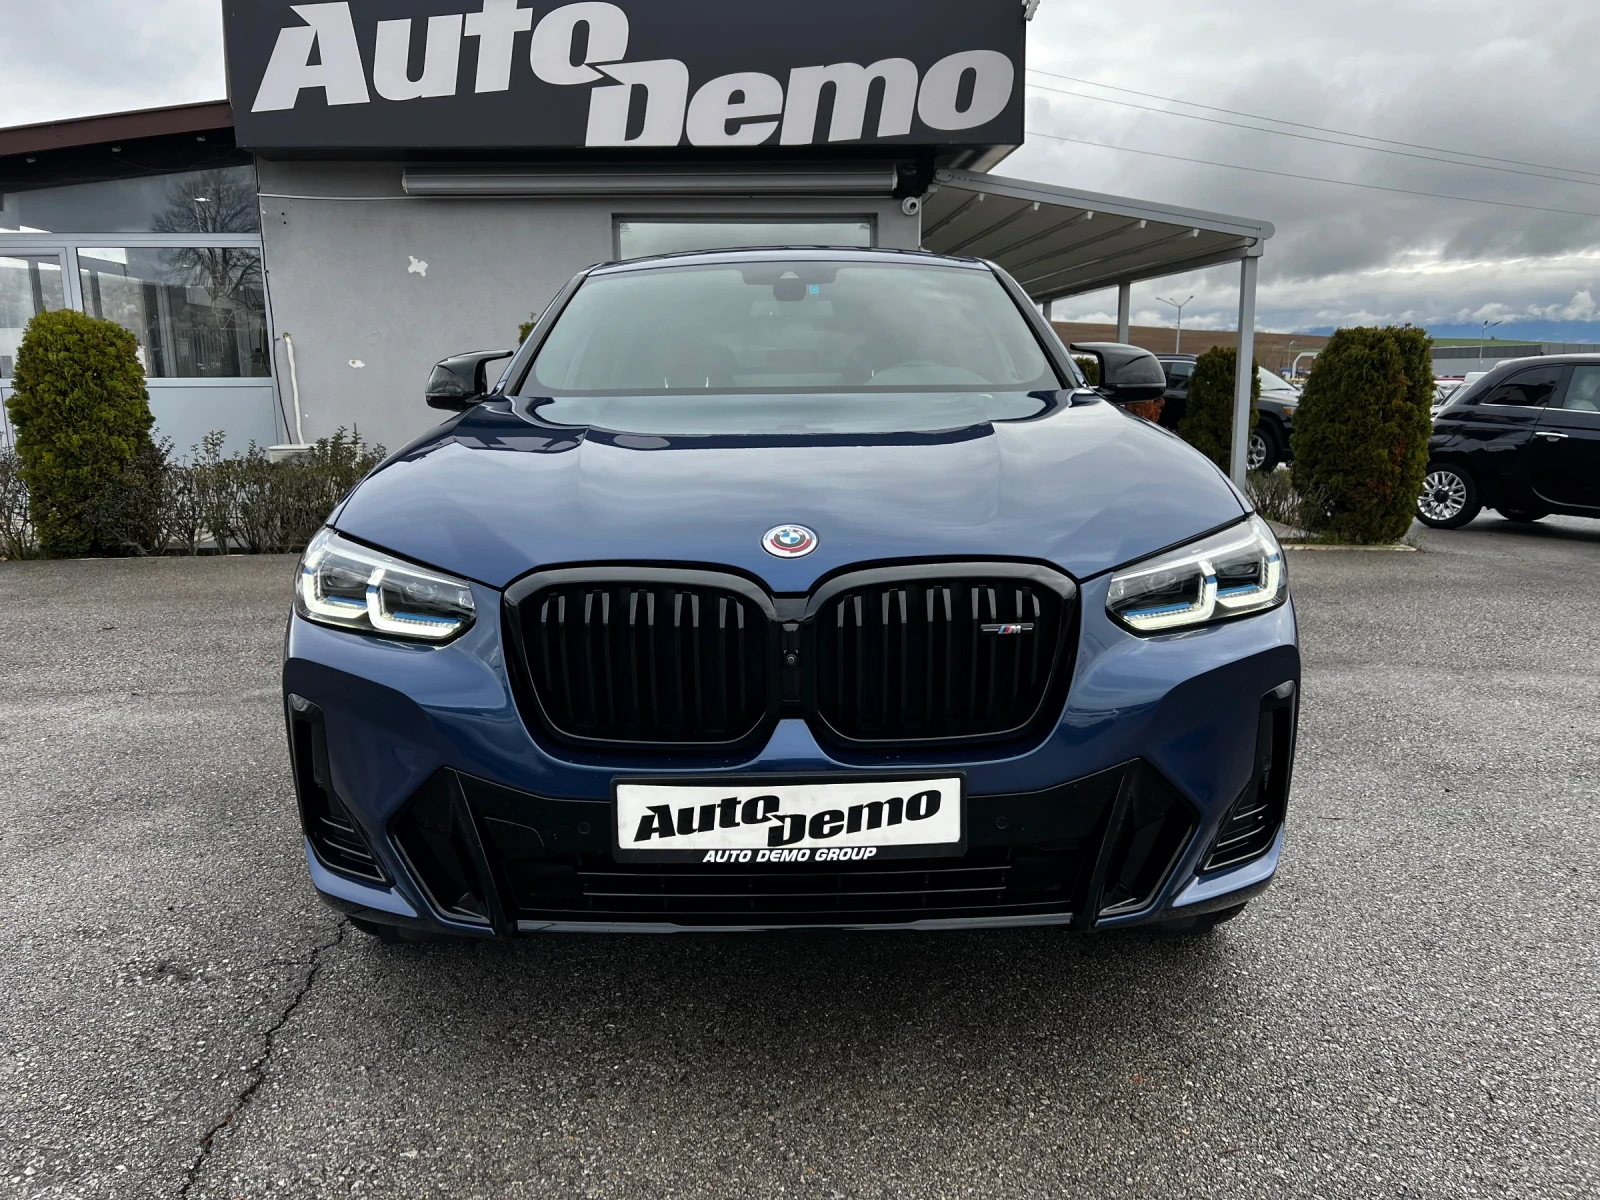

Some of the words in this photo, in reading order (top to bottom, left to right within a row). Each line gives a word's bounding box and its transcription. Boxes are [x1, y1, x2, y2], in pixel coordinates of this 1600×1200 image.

[251, 0, 630, 112] Auto
[585, 50, 1014, 147] Demo
[634, 795, 780, 842] Auto
[767, 790, 942, 847] Demo
[703, 849, 752, 863] AUTO
[756, 849, 811, 862] DEMO
[815, 847, 877, 861] GROUP
